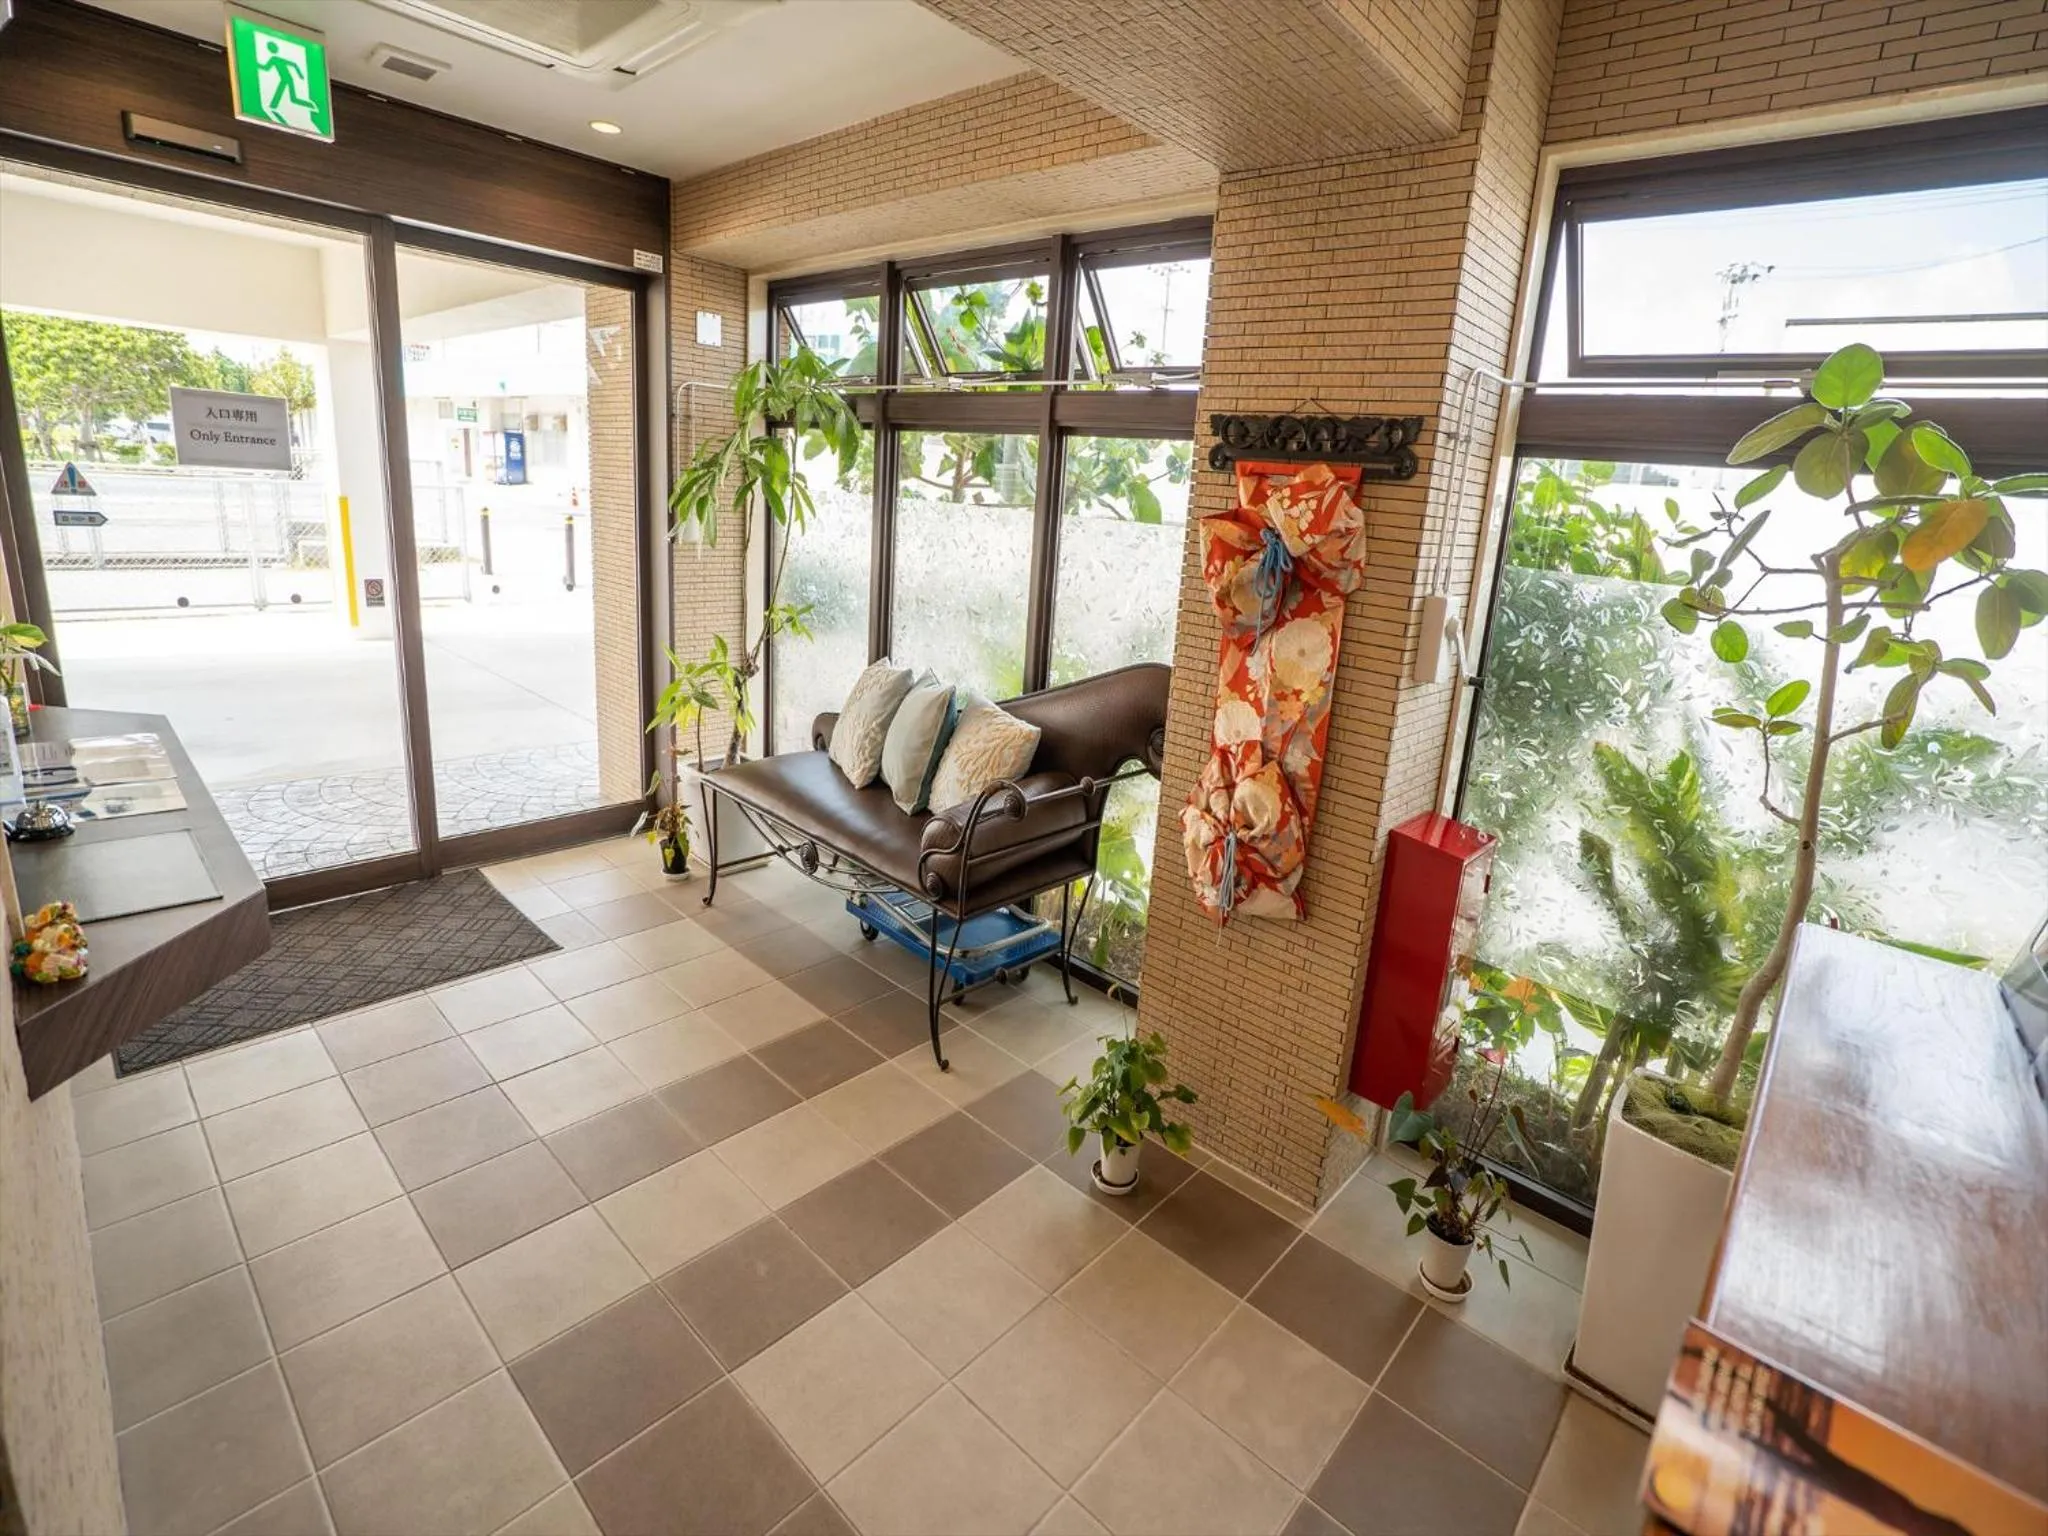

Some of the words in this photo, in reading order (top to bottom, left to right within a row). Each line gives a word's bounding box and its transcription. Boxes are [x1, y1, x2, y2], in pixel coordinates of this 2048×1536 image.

[206, 407, 257, 422] 入口専用
[189, 429, 221, 444] Only
[223, 431, 276, 446] Entrance
